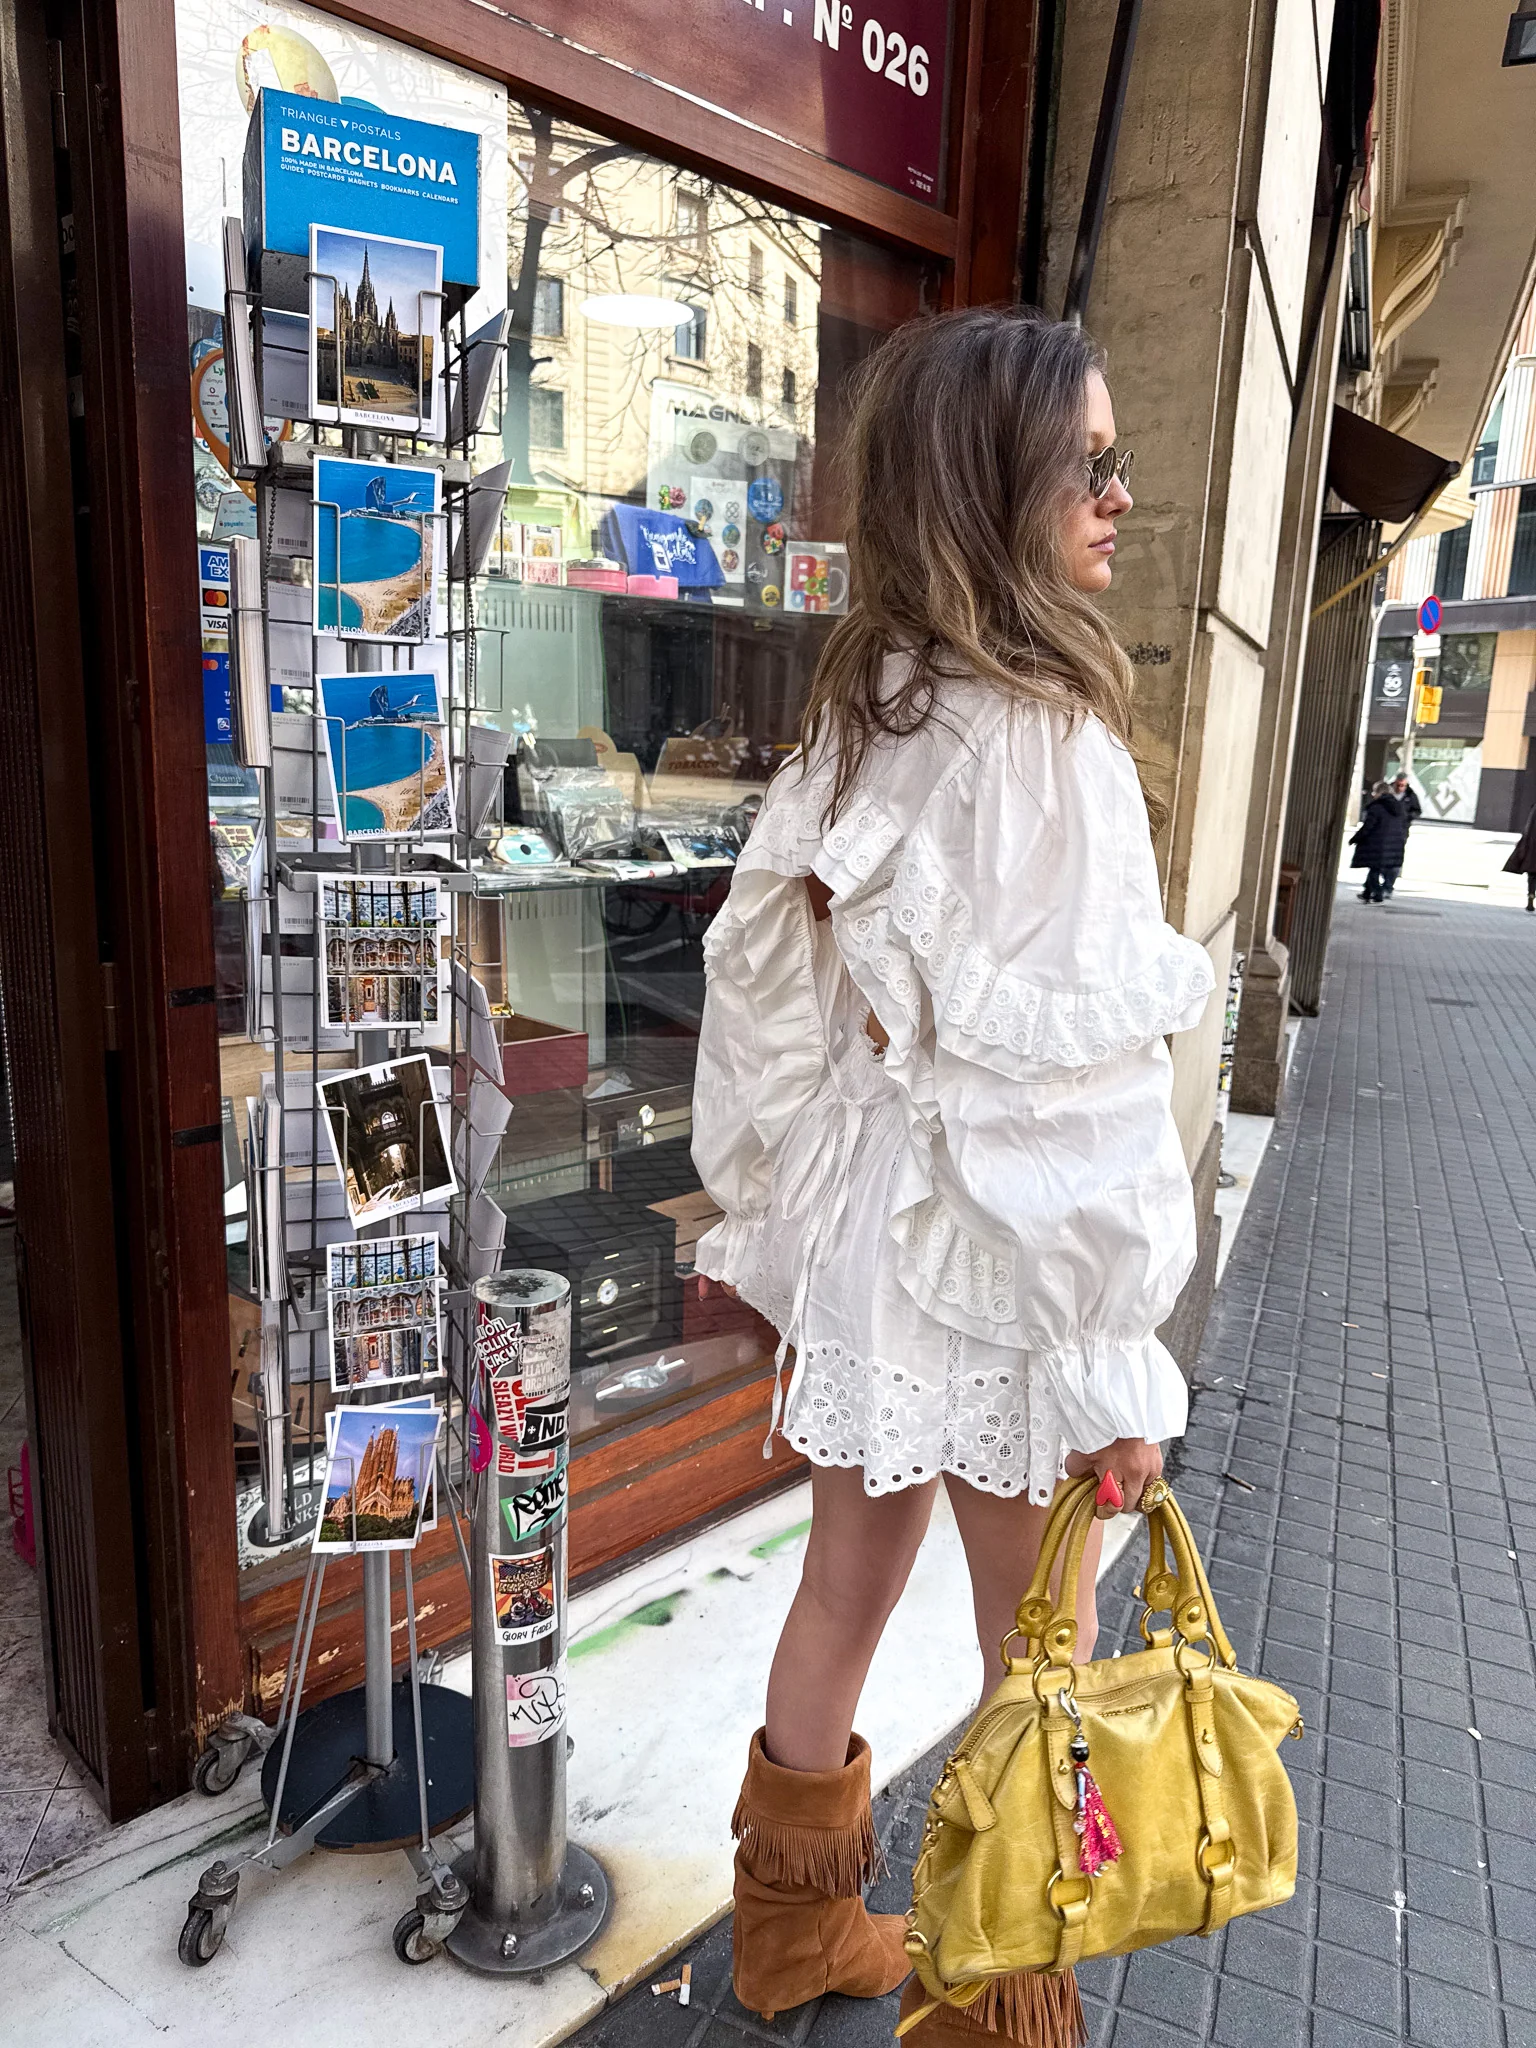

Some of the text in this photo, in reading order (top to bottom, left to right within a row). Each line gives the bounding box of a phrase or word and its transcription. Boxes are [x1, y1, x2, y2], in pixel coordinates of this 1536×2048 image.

[862, 18, 930, 97] 026
[280, 106, 402, 141] TRIANGLE POSTALS
[280, 156, 298, 165] 100%
[299, 159, 318, 168] MADE
[326, 165, 364, 178] BARCELONA
[281, 127, 458, 186] BARCELONA
[280, 163, 459, 205] GUIDES POSTCARDS MAGNETS BOOKMARKS CALENDARS
[354, 411, 395, 422] BARCELONA
[206, 619, 228, 630] VISA
[323, 624, 368, 634] BARCELONA
[347, 827, 391, 836] BARCELONA
[485, 1341, 519, 1368] CIRCUS
[492, 1380, 516, 1421] SLEAZY
[502, 1620, 553, 1642] GLORY FADES
